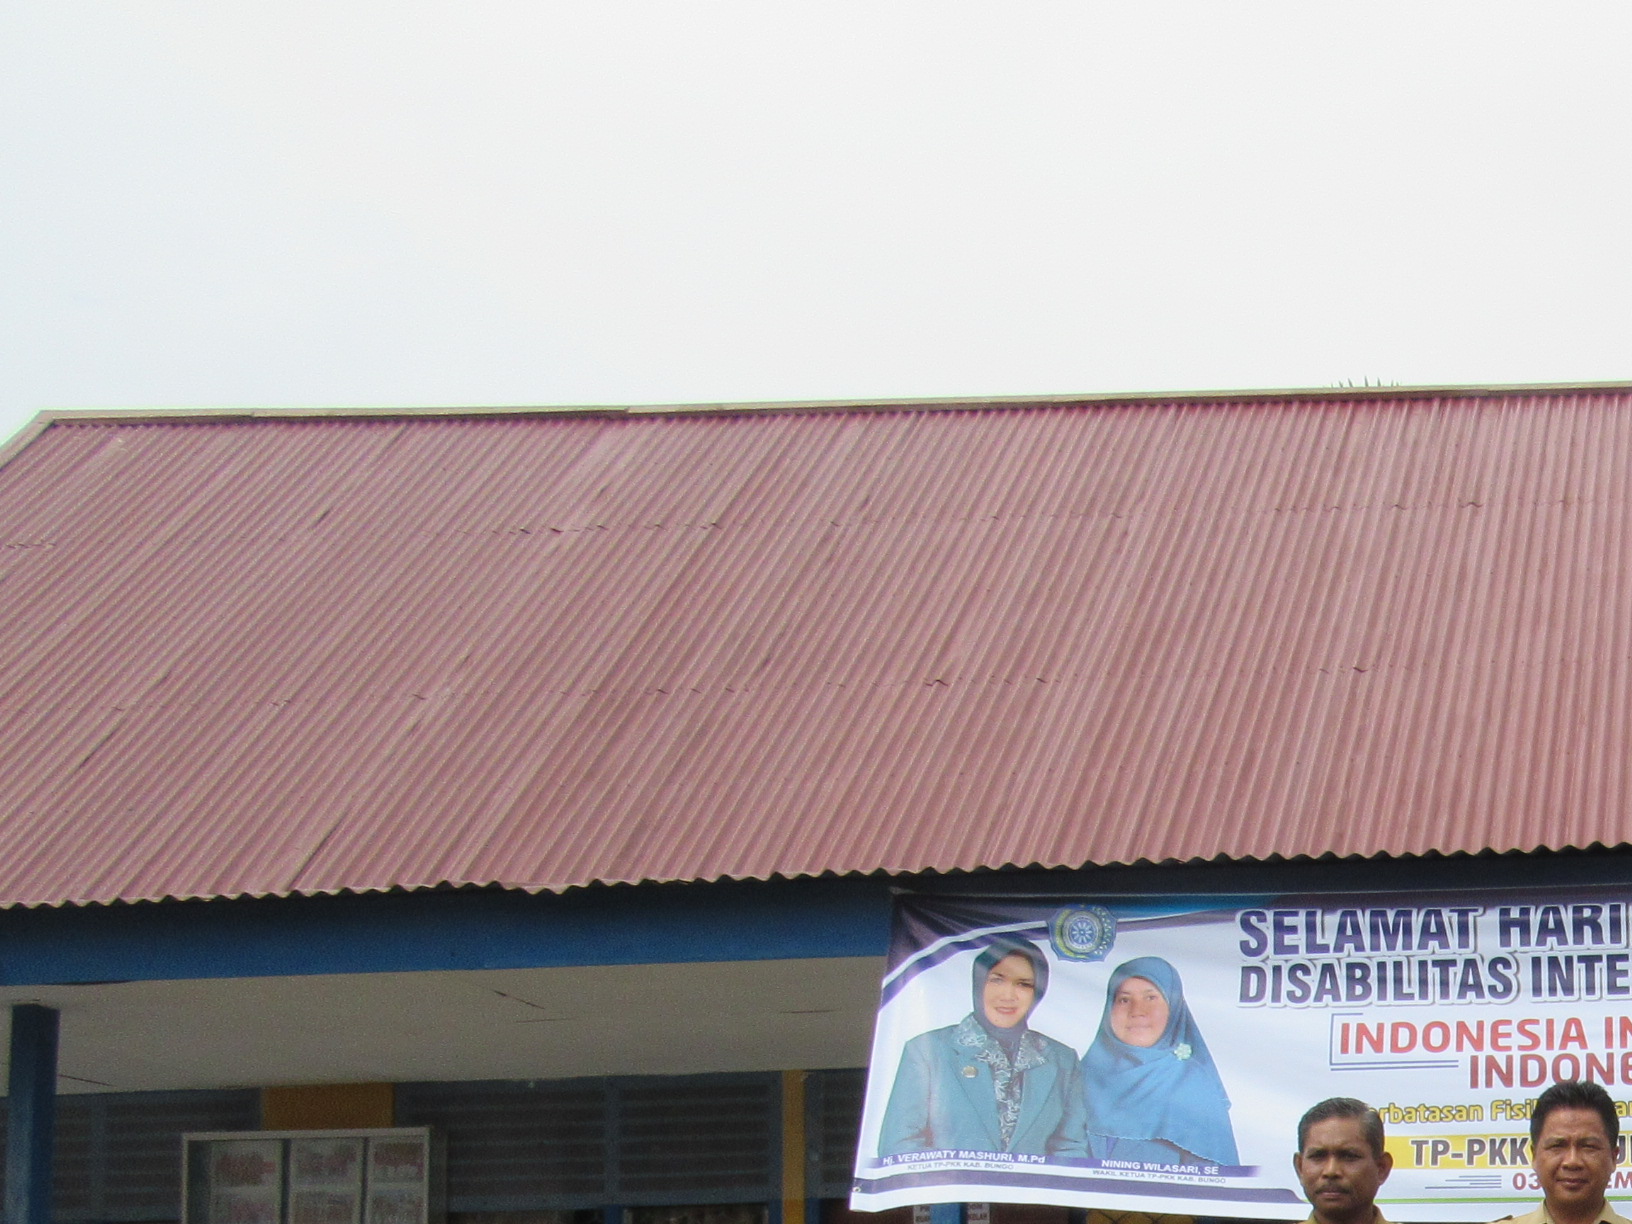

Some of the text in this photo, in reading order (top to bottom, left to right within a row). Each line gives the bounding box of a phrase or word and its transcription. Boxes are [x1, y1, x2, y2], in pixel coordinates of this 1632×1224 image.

[1239, 903, 1622, 957] SELAMAT HARI
[1239, 956, 1514, 1004] DISABILITAS
[1340, 1016, 1589, 1055] INDONESIA
[1369, 1102, 1485, 1125] rbatasan
[882, 1150, 1046, 1167] Hj. VERAWATY MASHURI, M.Pd
[1410, 1137, 1530, 1167] TP-PKK
[907, 1162, 932, 1170] KETUA
[984, 1162, 1014, 1170] BUNGO
[1101, 1160, 1219, 1175] NINING WILASARI, SE
[1197, 1176, 1227, 1184] BUNGO
[1512, 1172, 1543, 1191] 03
